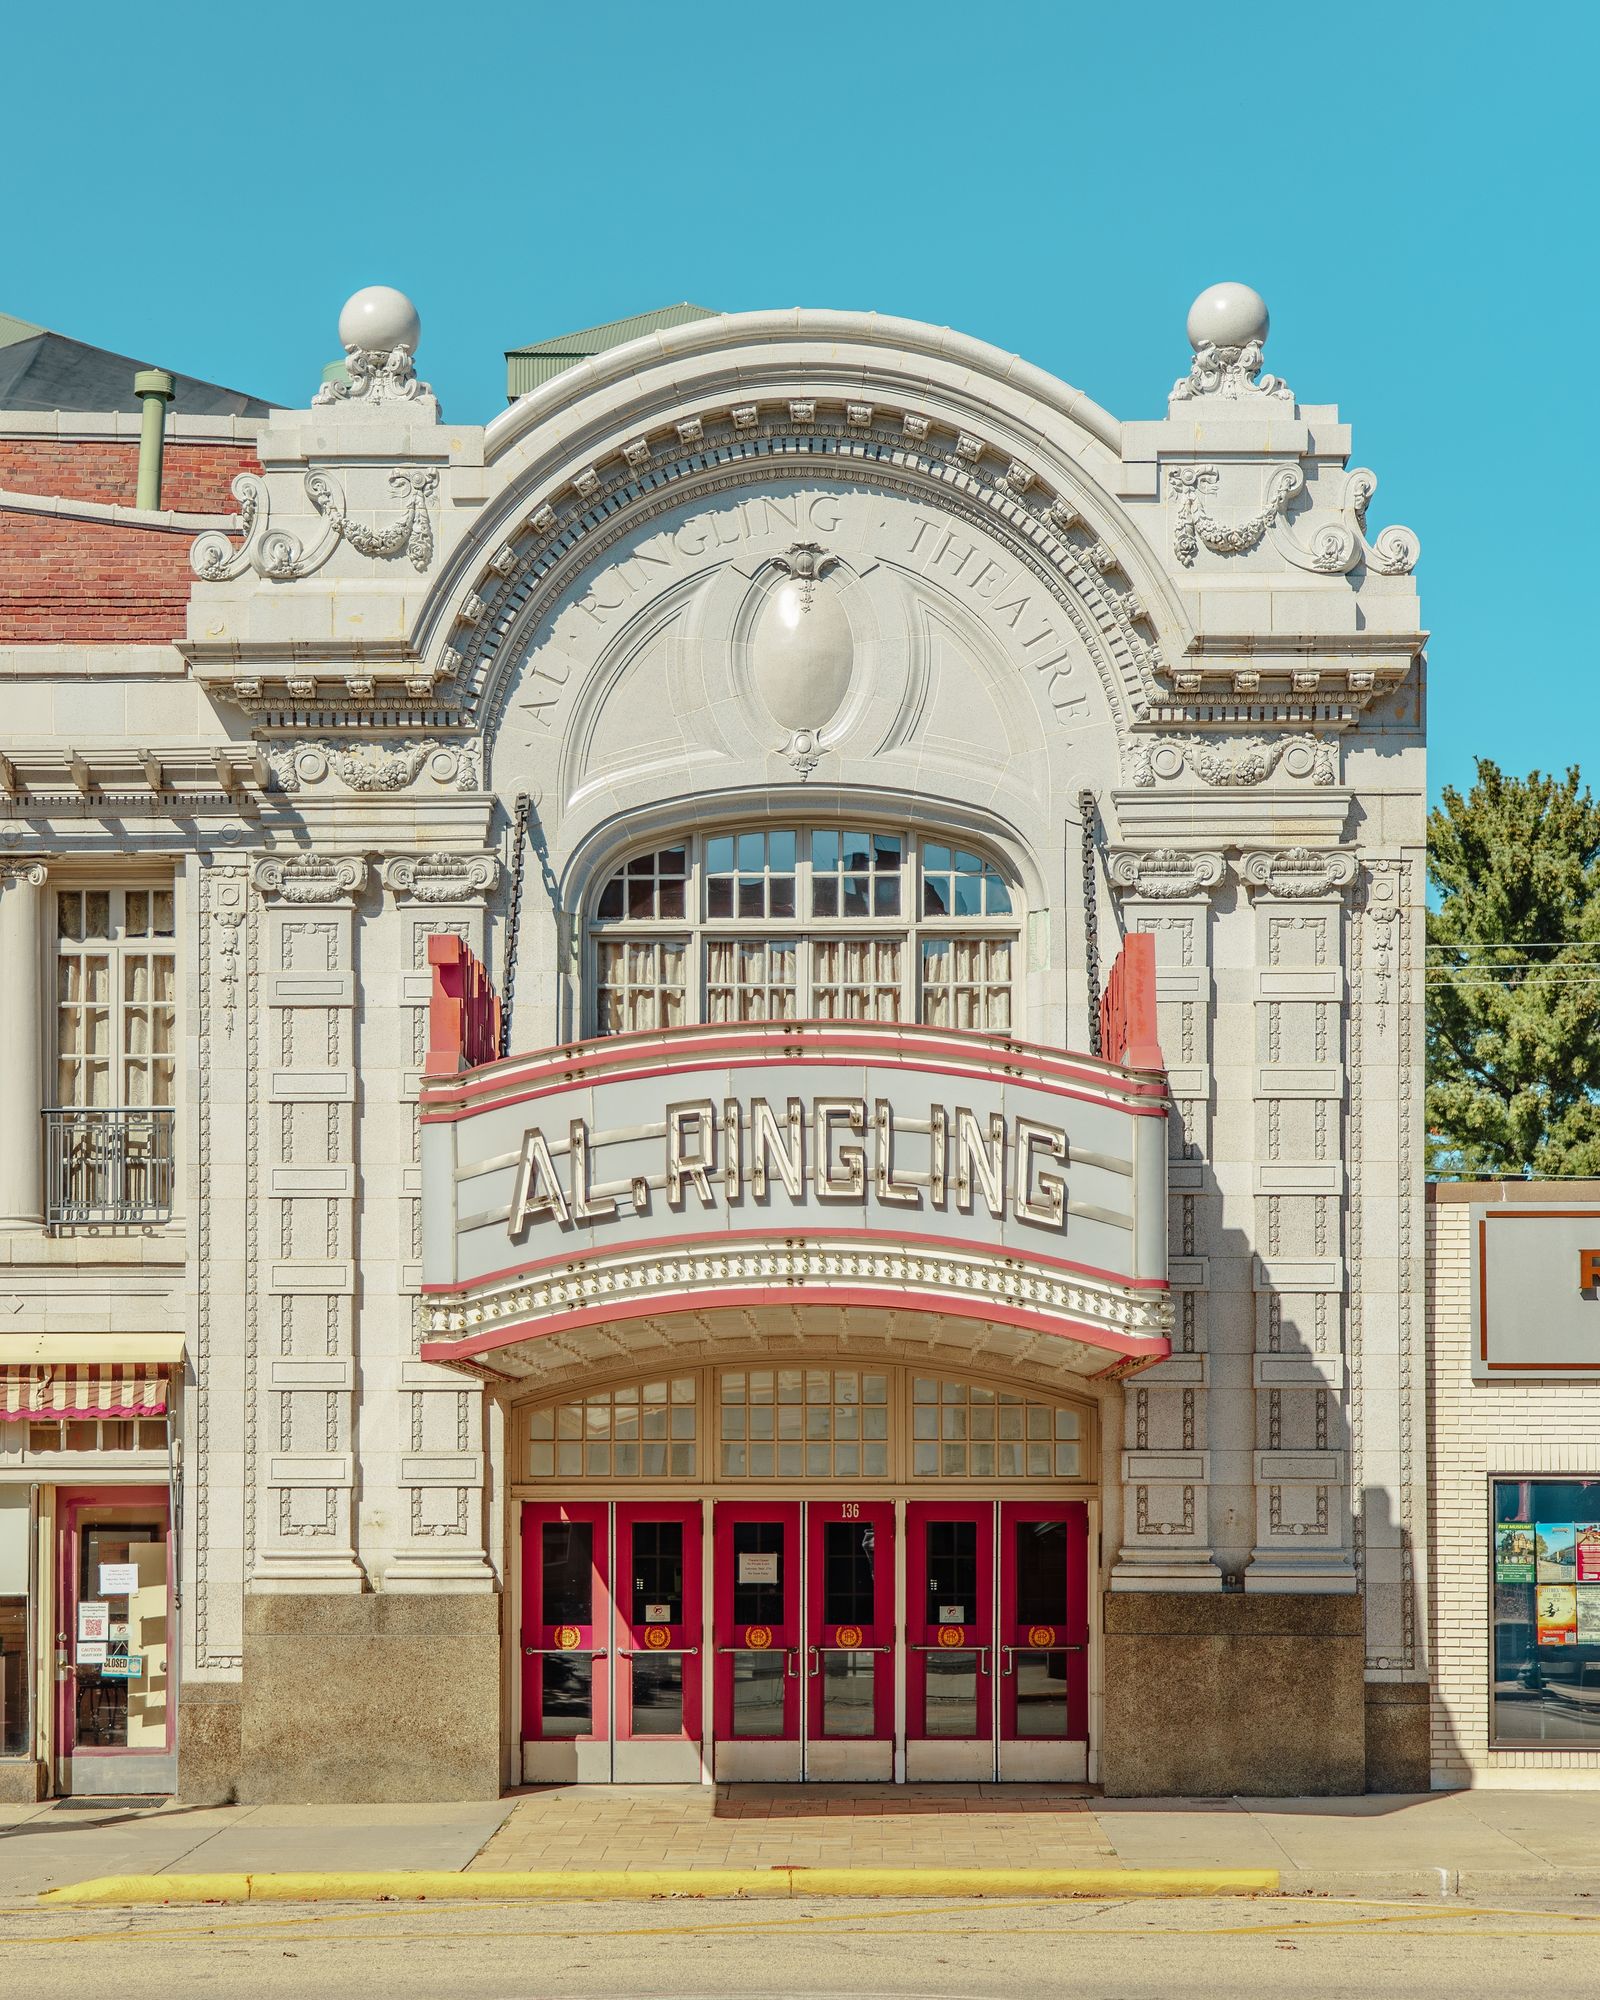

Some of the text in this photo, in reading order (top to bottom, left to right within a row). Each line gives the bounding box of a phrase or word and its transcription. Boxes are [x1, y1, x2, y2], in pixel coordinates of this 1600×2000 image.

[518, 495, 1091, 728] AL RINGLING THEATRE
[665, 1096, 1067, 1228] RINGLING
[841, 1503, 860, 1518] 136
[104, 1658, 128, 1668] CLOSED
